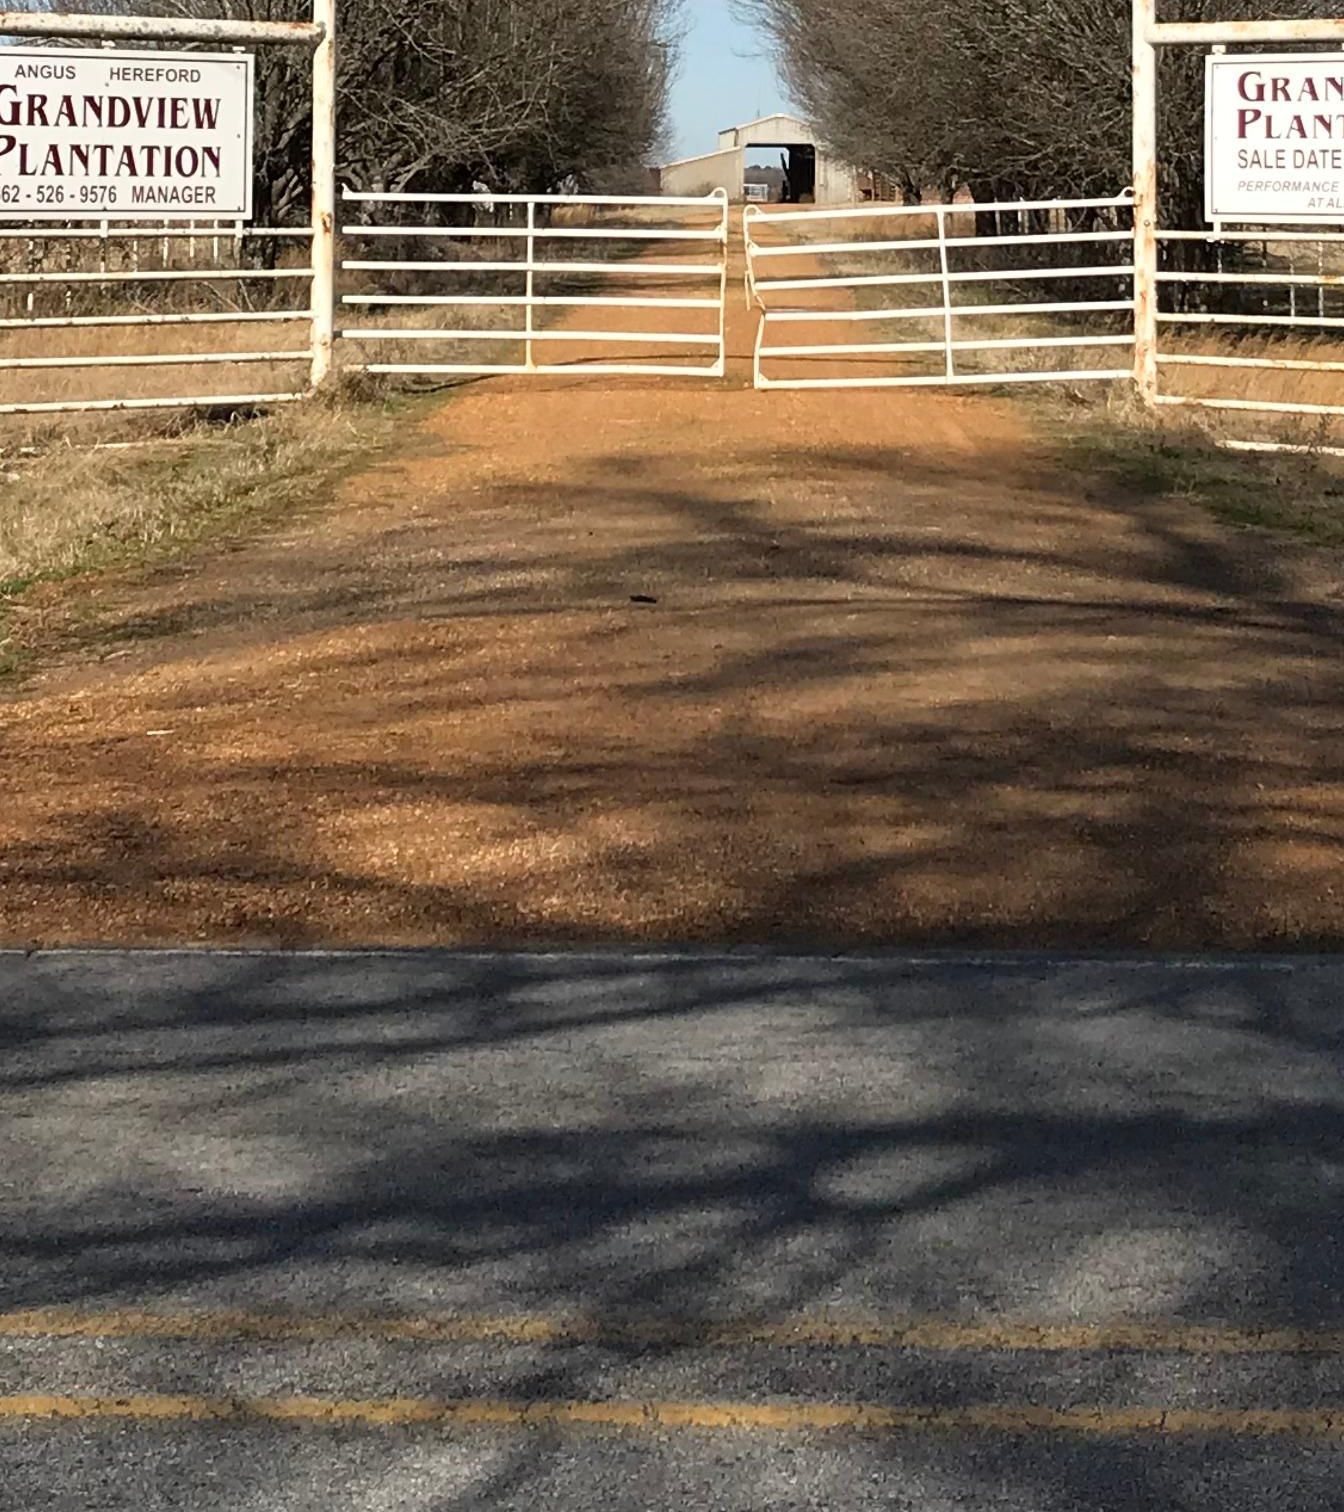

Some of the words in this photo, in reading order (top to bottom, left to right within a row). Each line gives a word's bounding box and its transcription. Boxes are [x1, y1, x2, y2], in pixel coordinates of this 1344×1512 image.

[15, 65, 76, 80] ANGUS
[110, 67, 201, 83] HEREFORD
[1237, 150, 1286, 169] SALE
[132, 186, 215, 204] MANAGER
[1237, 180, 1339, 193] PERFORMANCE
[1308, 198, 1326, 208] AT
